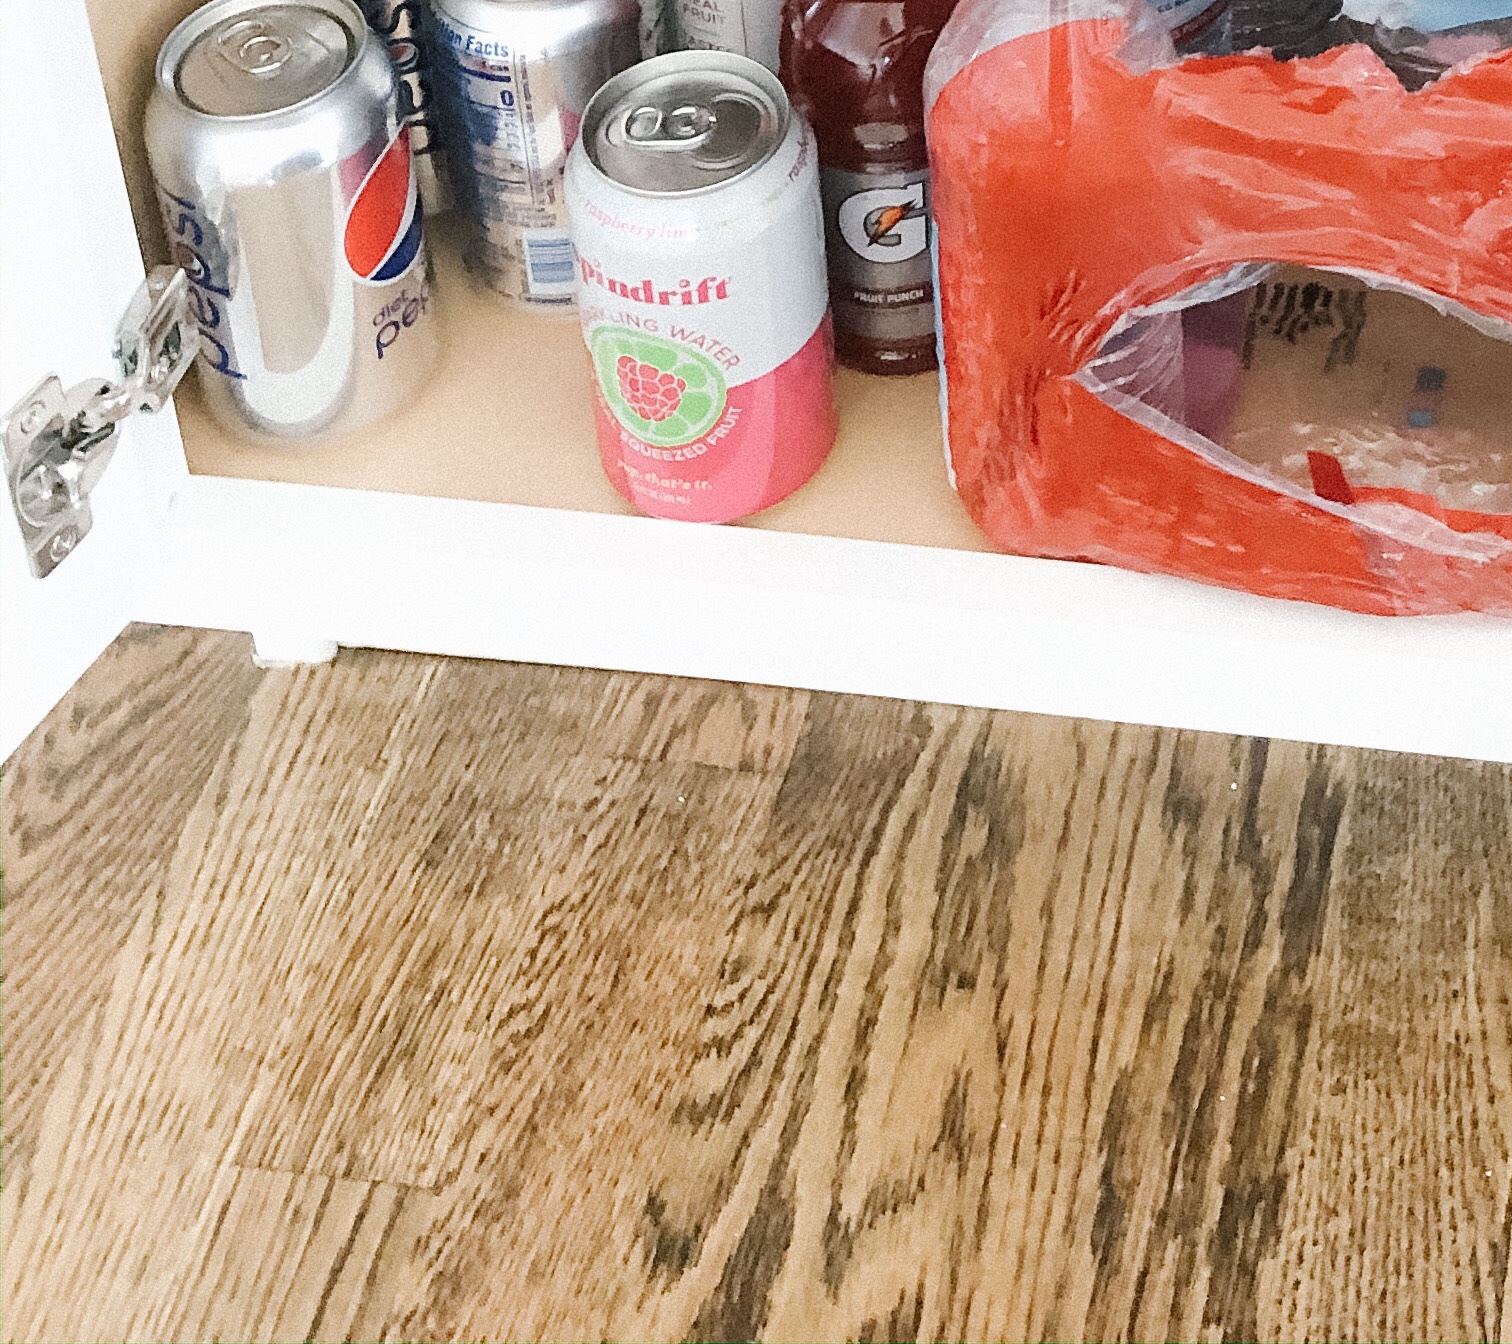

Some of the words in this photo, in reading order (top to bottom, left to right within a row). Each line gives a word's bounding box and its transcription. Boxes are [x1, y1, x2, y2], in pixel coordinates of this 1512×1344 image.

[682, 5, 726, 27] FRUIT
[466, 33, 511, 60] Facts
[838, 183, 929, 265] G
[853, 290, 887, 305] FRUIT
[888, 289, 924, 306] PUNCH
[669, 326, 742, 376] WATER
[621, 429, 709, 466] SQUEEZED
[707, 404, 744, 451] FRUIT
